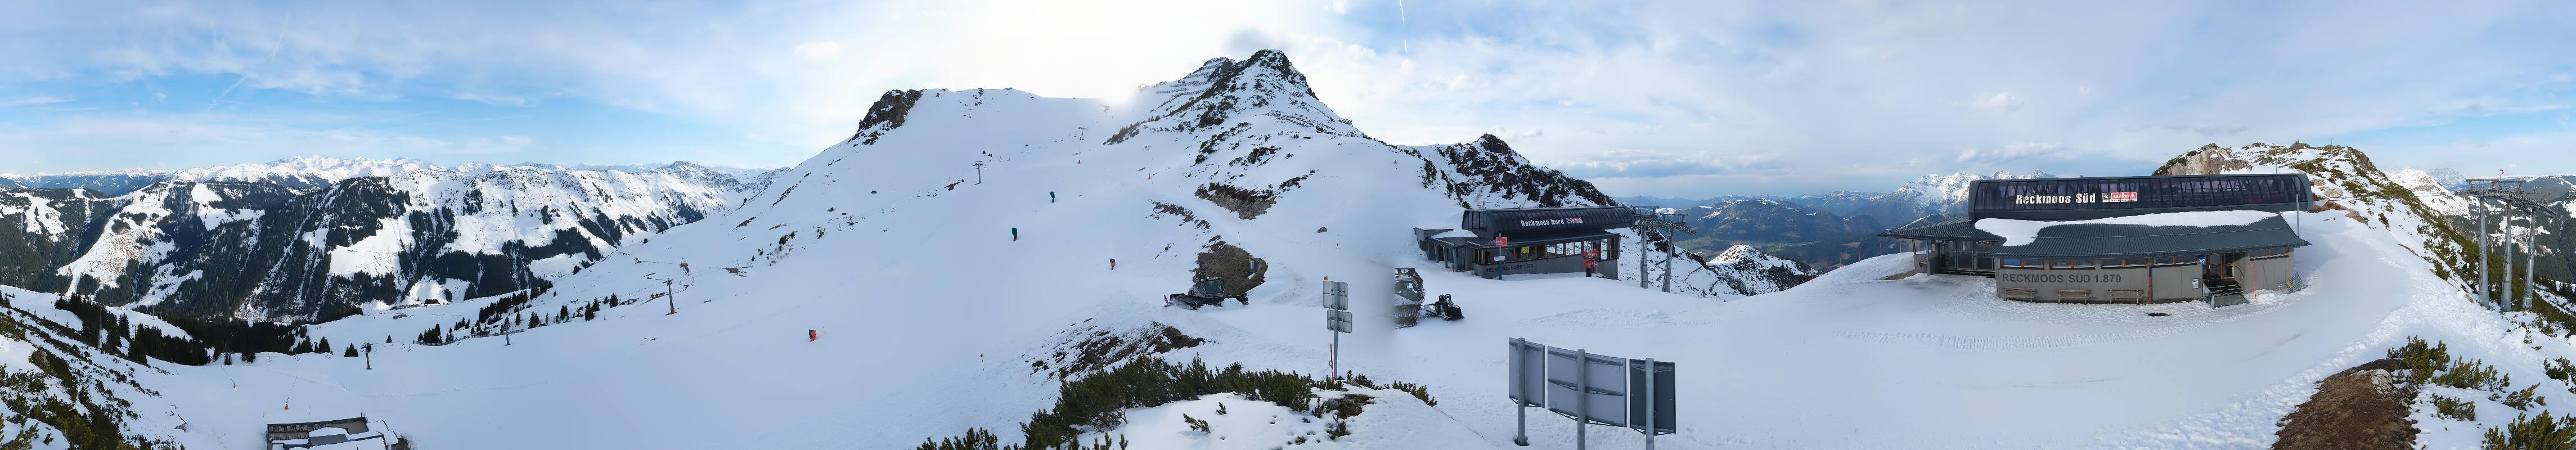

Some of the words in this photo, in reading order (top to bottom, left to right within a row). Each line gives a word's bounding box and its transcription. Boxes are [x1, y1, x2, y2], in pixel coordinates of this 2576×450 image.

[2016, 194, 2071, 204] Reckmoos
[2075, 192, 2096, 204] Süd
[2002, 273, 2064, 283] RECKMOOS
[2068, 273, 2091, 283] SÜD
[2094, 274, 2121, 283] 1.870
